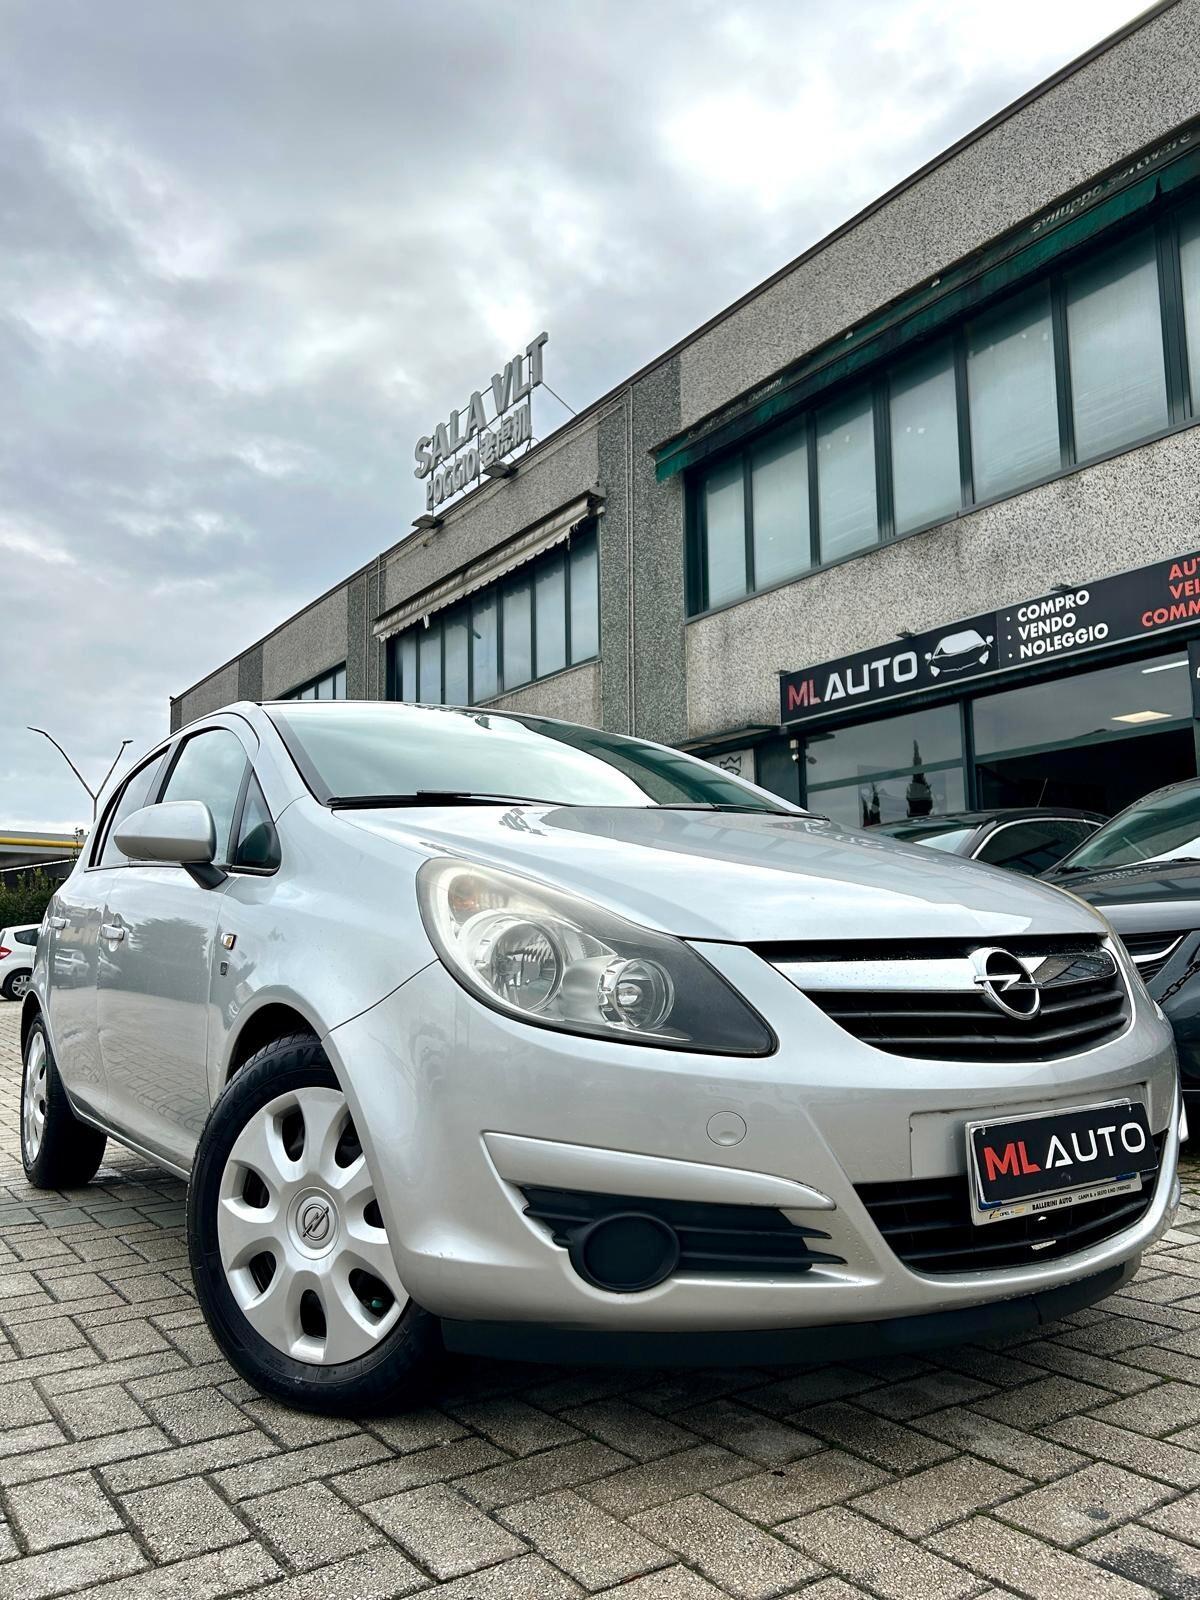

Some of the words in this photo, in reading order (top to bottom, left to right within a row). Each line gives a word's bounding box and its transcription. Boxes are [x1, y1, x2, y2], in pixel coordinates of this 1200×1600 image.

[414, 391, 487, 480] SALA
[491, 331, 549, 416] VLT
[426, 448, 480, 511] POGGIO
[1168, 557, 1200, 580] AU
[1016, 589, 1090, 623] COMPRO
[1017, 612, 1076, 641] VENDO
[1019, 622, 1109, 659] NOLEGGIO
[786, 679, 822, 712] ML
[824, 650, 918, 702] AUTO
[983, 1140, 1042, 1182] ML
[1045, 1122, 1146, 1170] AUTO
[1032, 1200, 1058, 1211] BALLERINI
[1058, 1196, 1073, 1205] AUTO
